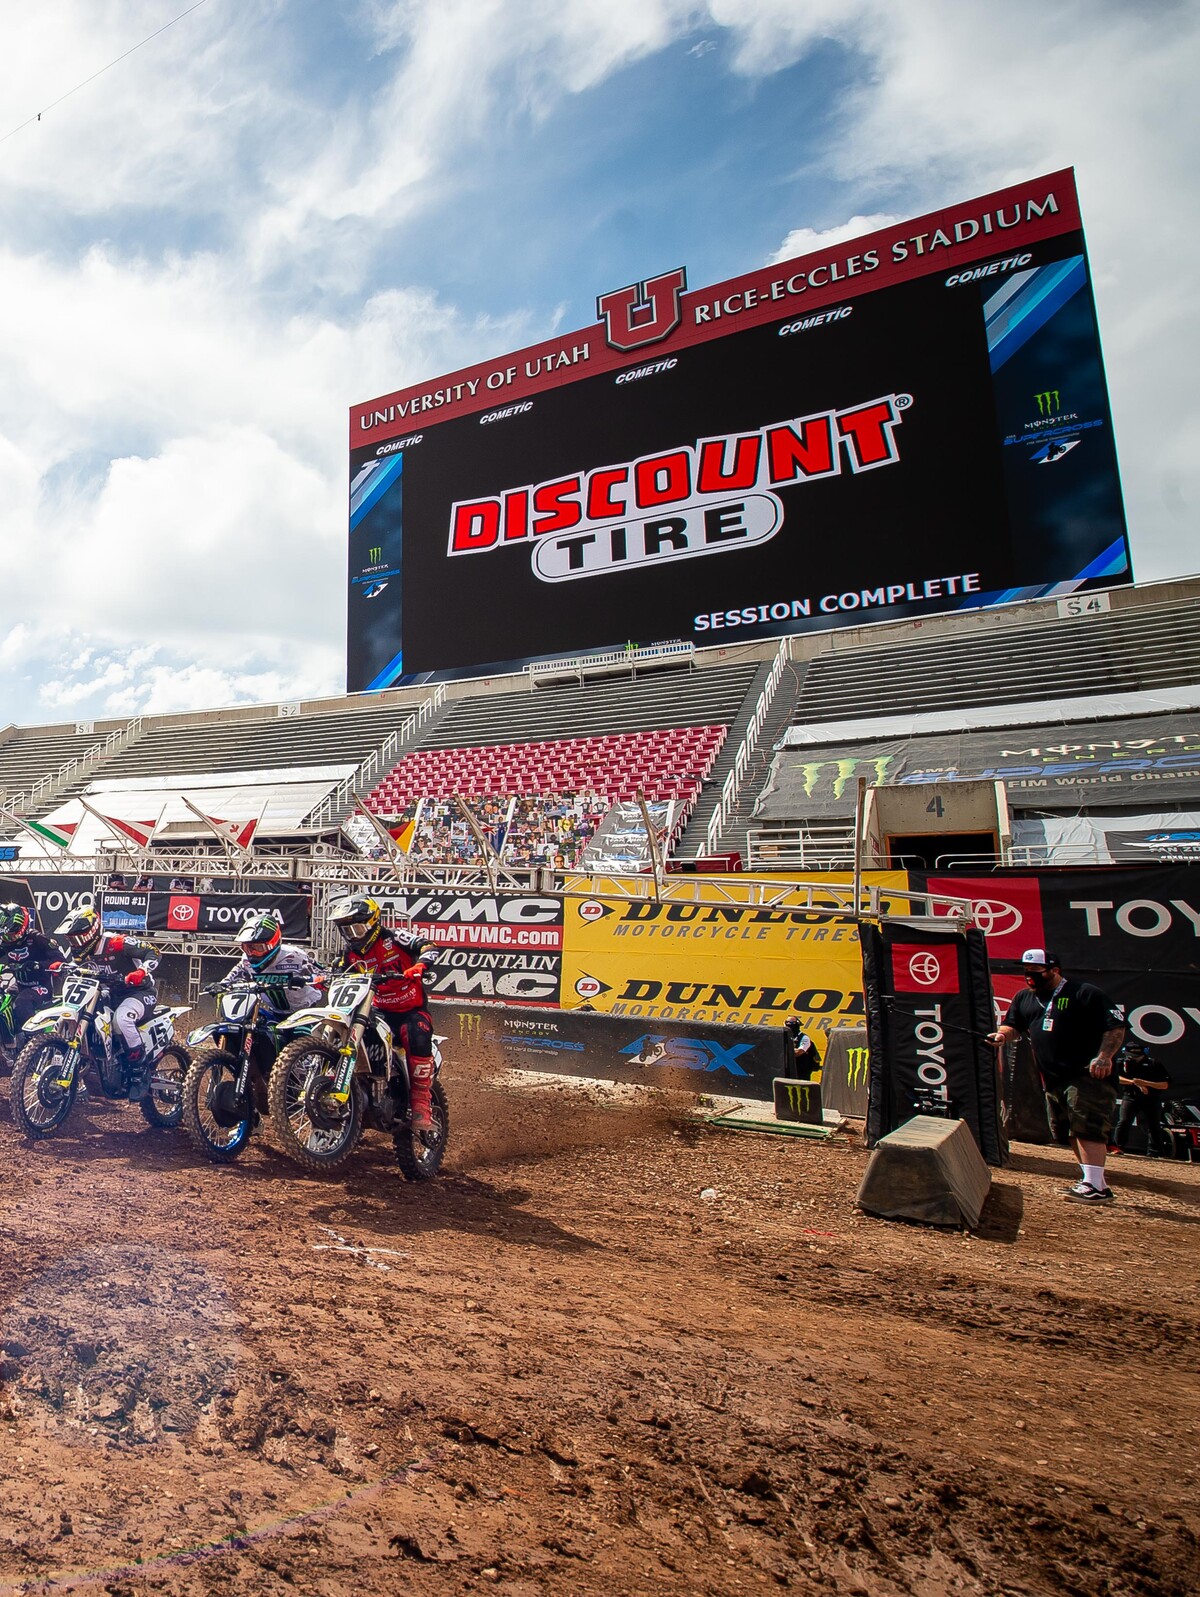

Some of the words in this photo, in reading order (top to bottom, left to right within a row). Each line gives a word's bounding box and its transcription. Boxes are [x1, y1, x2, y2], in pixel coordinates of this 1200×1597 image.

[695, 250, 880, 325] RICE-ECCLES
[892, 193, 1060, 265] STADIUM
[945, 253, 1033, 288] COMETIC
[596, 265, 687, 352] U
[778, 306, 853, 336] COMETIC
[615, 358, 678, 385] COMETIC
[360, 378, 481, 430] UNIVERSITY
[486, 366, 518, 391] OF
[525, 342, 590, 379] UTAH
[479, 401, 534, 425] COMETIC
[376, 435, 424, 456] COMETIC
[449, 398, 899, 555] DISCOUNT
[556, 503, 747, 570] TIRE
[694, 599, 811, 631] SESSION
[819, 573, 981, 613] COMPLETE
[911, 766, 959, 775] AMA
[1008, 779, 1048, 788] FIM
[1055, 773, 1122, 785] World
[925, 795, 945, 818] 4
[104, 896, 130, 905] ROUND
[131, 896, 146, 906] #11
[613, 924, 772, 940] MOTORCYCLE
[785, 927, 860, 942] TIRES
[433, 948, 560, 972] MOUNTAIN
[253, 975, 289, 984] THOR
[65, 983, 90, 1005] 15
[231, 994, 248, 1016] 7
[332, 985, 360, 1008] 16
[503, 1020, 559, 1032] MONSTER
[799, 1016, 866, 1030] IRES
[914, 1003, 948, 1109] TOYOT
[240, 1059, 250, 1095] DUNLOP
[336, 1056, 349, 1091] DUNLOP
